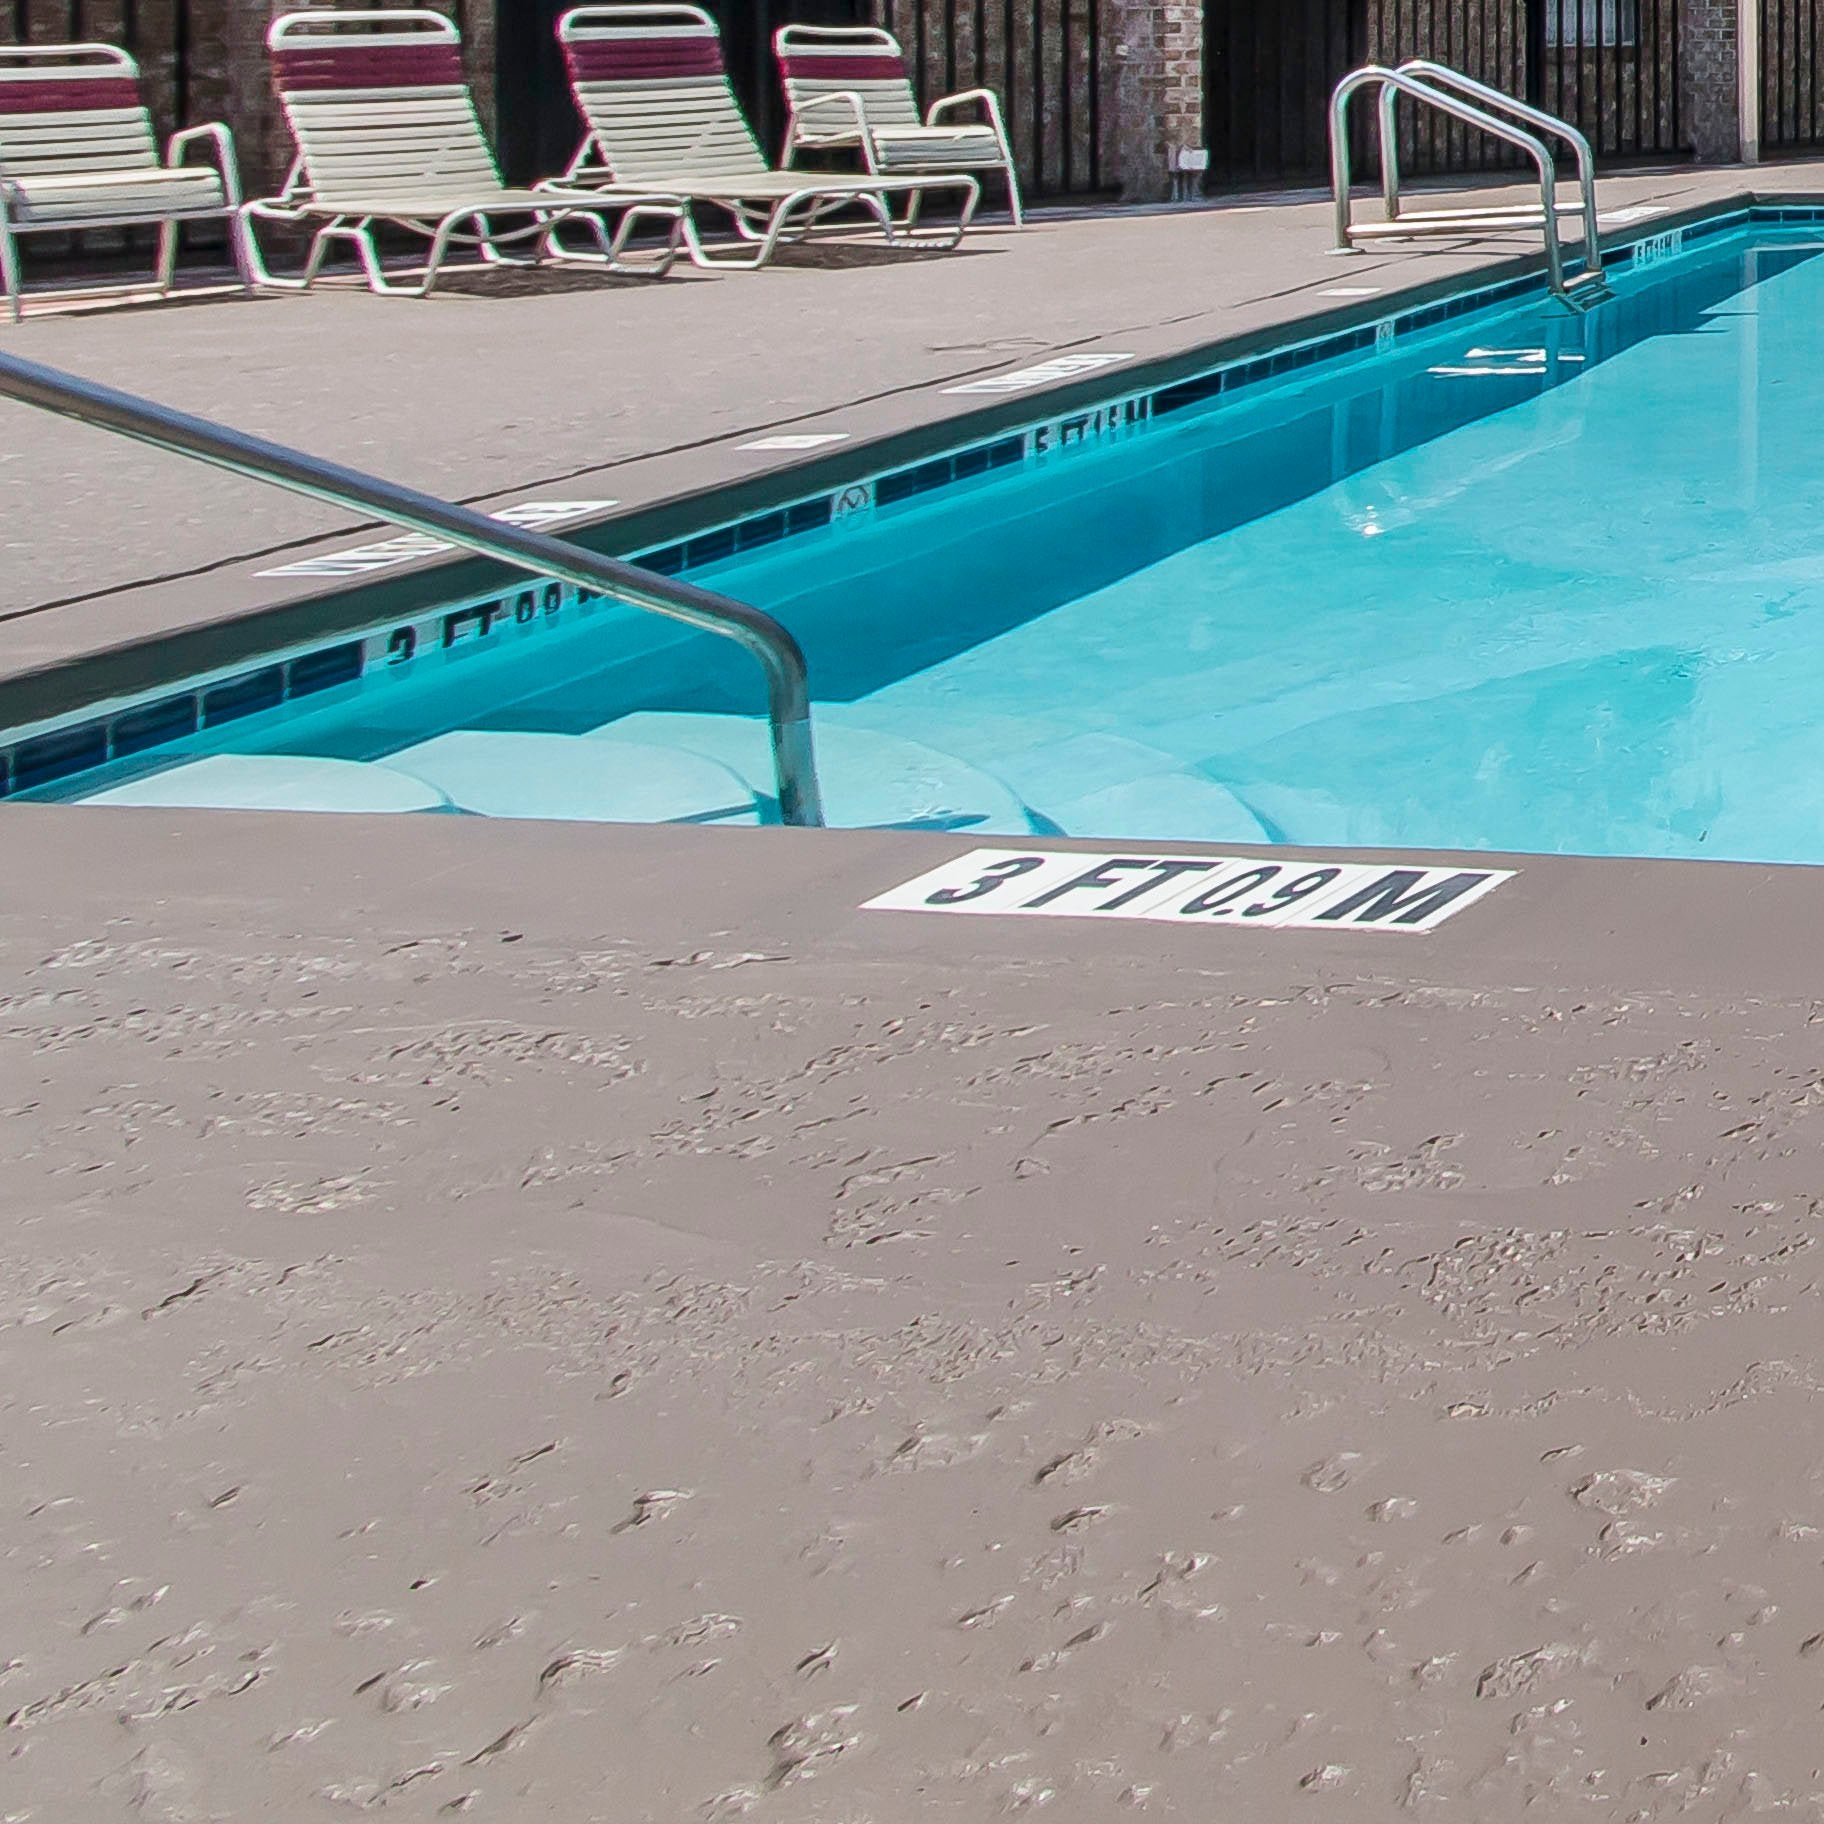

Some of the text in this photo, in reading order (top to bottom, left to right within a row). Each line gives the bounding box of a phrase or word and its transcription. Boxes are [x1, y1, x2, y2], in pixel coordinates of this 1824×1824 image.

[924, 856, 1496, 924] 3 FT 0.9 M
